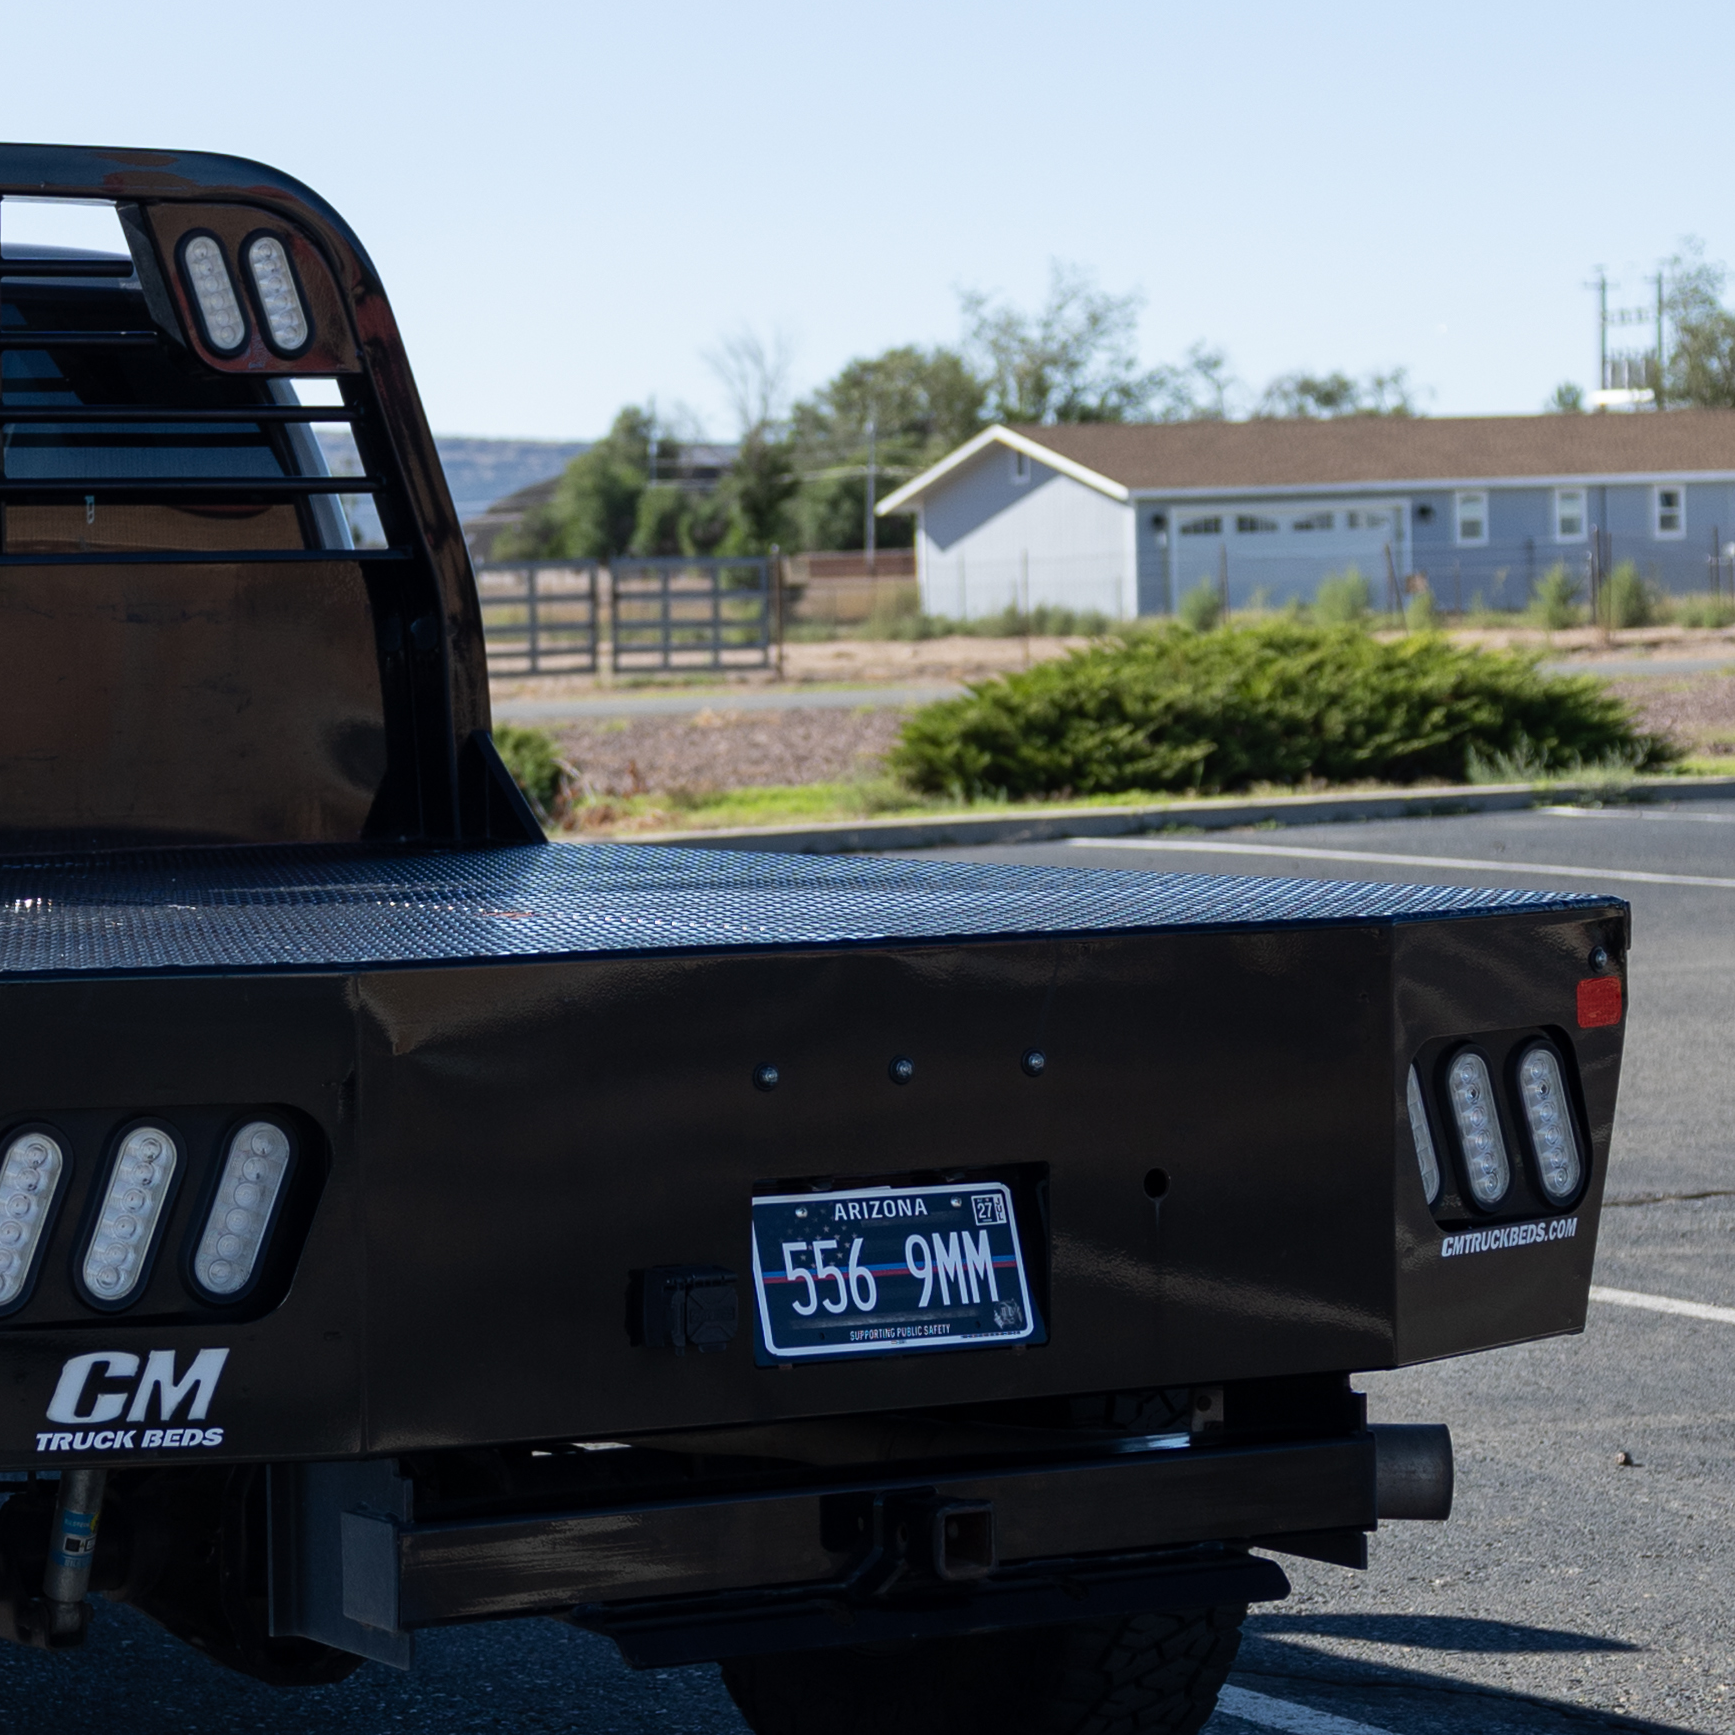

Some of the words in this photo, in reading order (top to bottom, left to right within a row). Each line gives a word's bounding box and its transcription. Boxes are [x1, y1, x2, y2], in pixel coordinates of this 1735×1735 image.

[834, 1198, 928, 1221] ARIZONA
[977, 1202, 992, 1219] 27
[995, 1197, 1004, 1221] JUL
[1441, 1217, 1578, 1257] CMTRUCKBEDS.COM
[782, 1238, 877, 1315] 556
[905, 1229, 999, 1308] 9MM
[850, 1327, 895, 1341] SUPPORTING
[897, 1325, 922, 1337] PUBLIC
[924, 1323, 950, 1335] SAFETY
[46, 1347, 230, 1424] CM
[36, 1430, 136, 1451] TRUCK
[141, 1428, 224, 1448] BEDS
